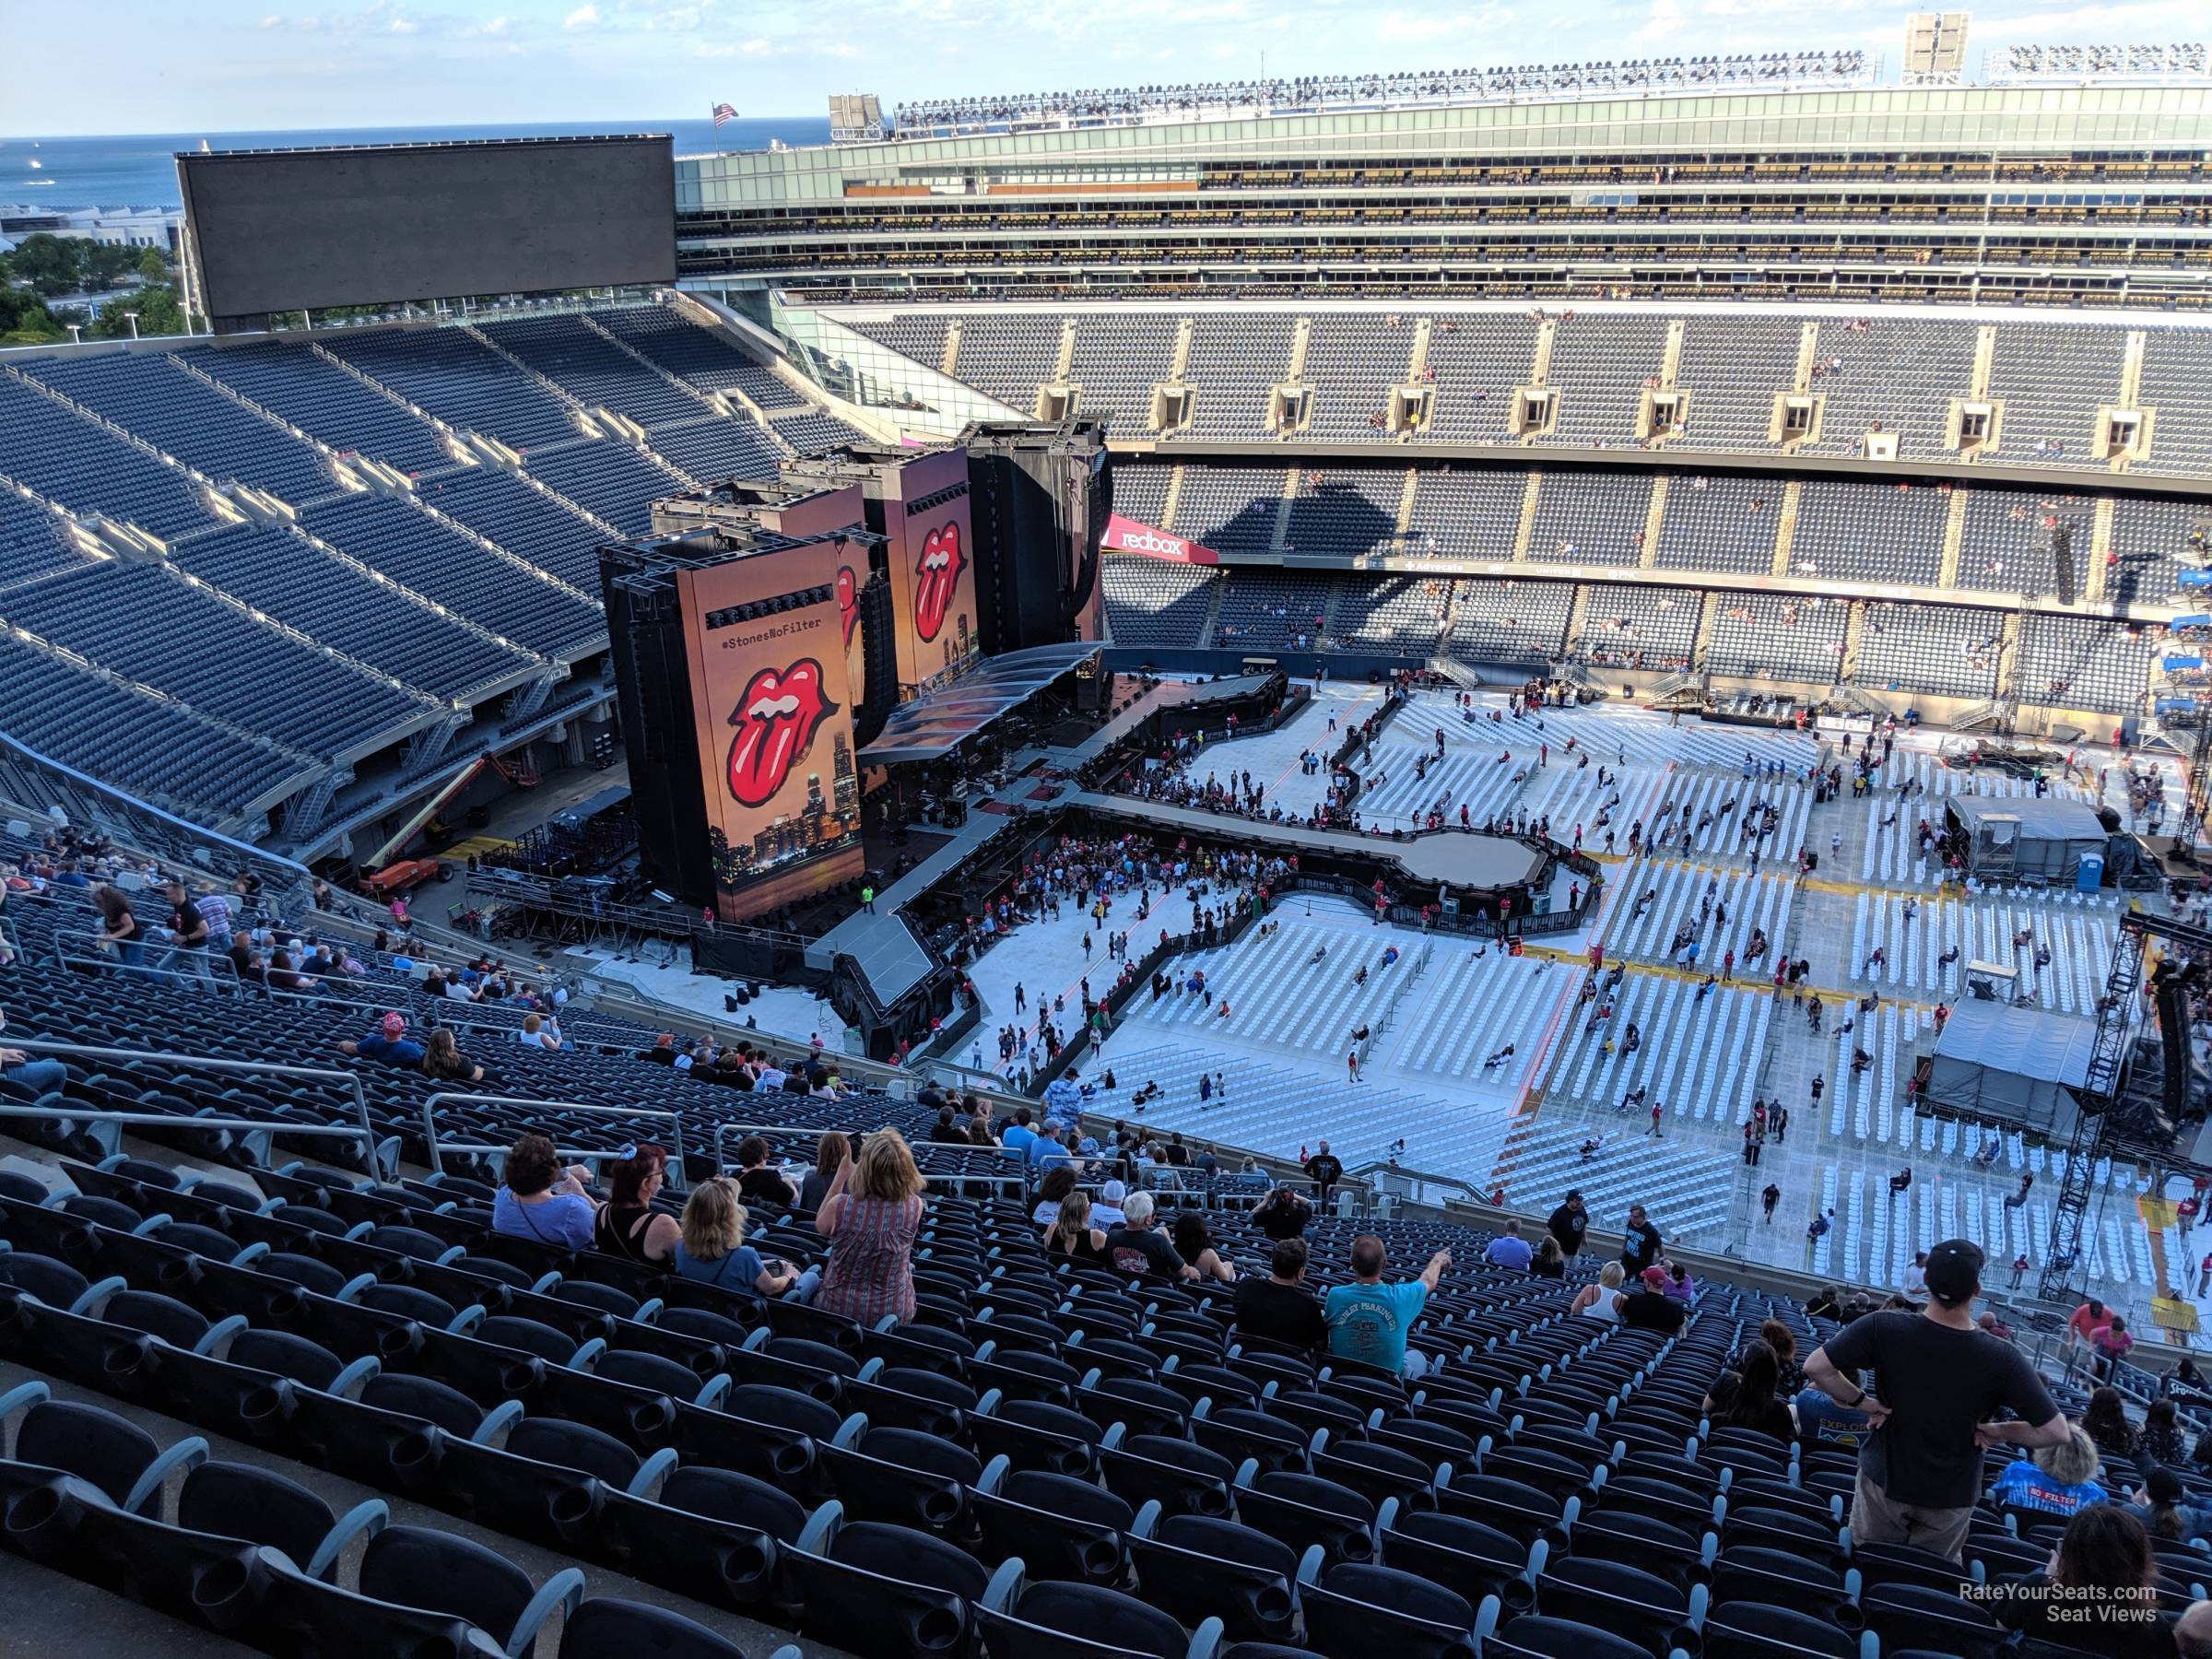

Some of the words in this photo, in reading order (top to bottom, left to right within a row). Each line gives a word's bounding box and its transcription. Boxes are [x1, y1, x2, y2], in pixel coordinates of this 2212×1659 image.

[1122, 531, 1184, 555] redbox
[722, 618, 822, 650] #StonesNoFilter
[2030, 1488, 2041, 1497] NO
[2044, 1491, 2077, 1506] FILTER
